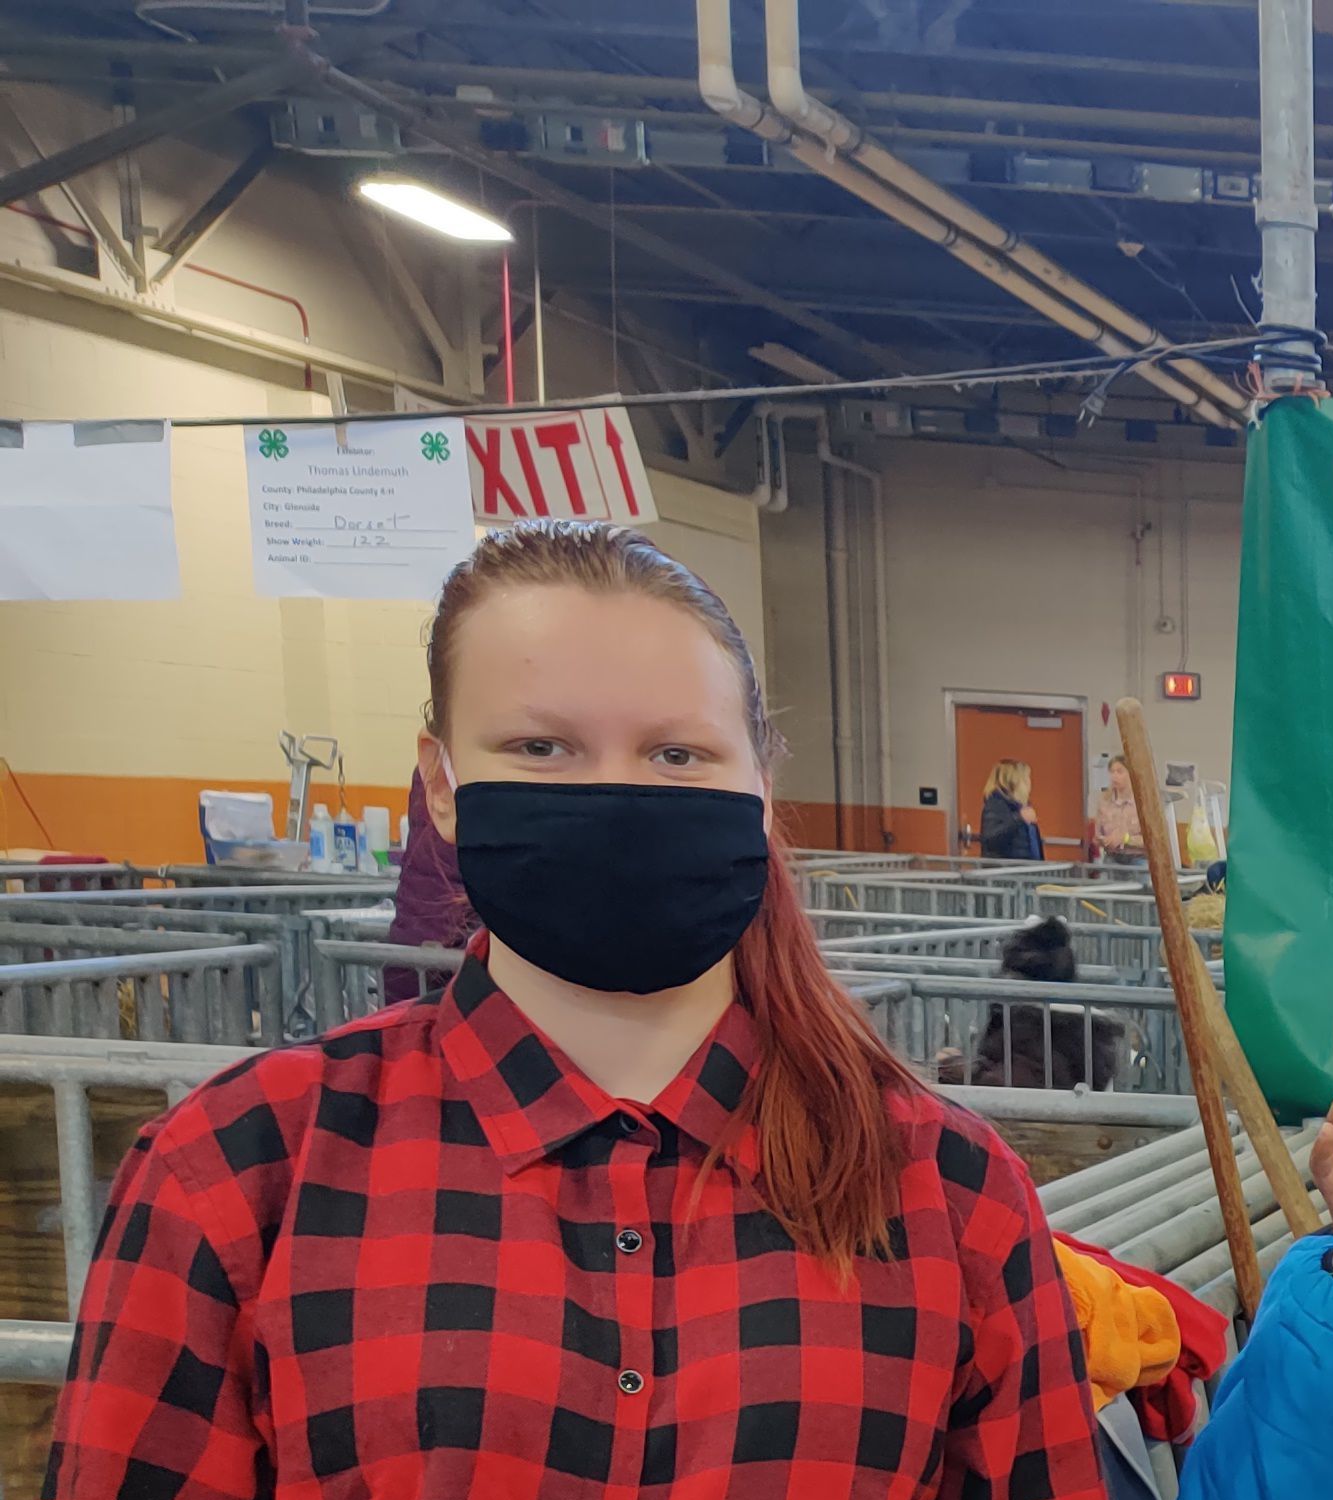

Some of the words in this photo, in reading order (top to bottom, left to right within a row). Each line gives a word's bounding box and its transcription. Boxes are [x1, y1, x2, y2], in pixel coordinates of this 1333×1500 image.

[307, 465, 349, 477] Thomas
[352, 466, 409, 478] Lindemuth
[466, 422, 586, 516] XIT
[296, 485, 348, 496] Philadelphia
